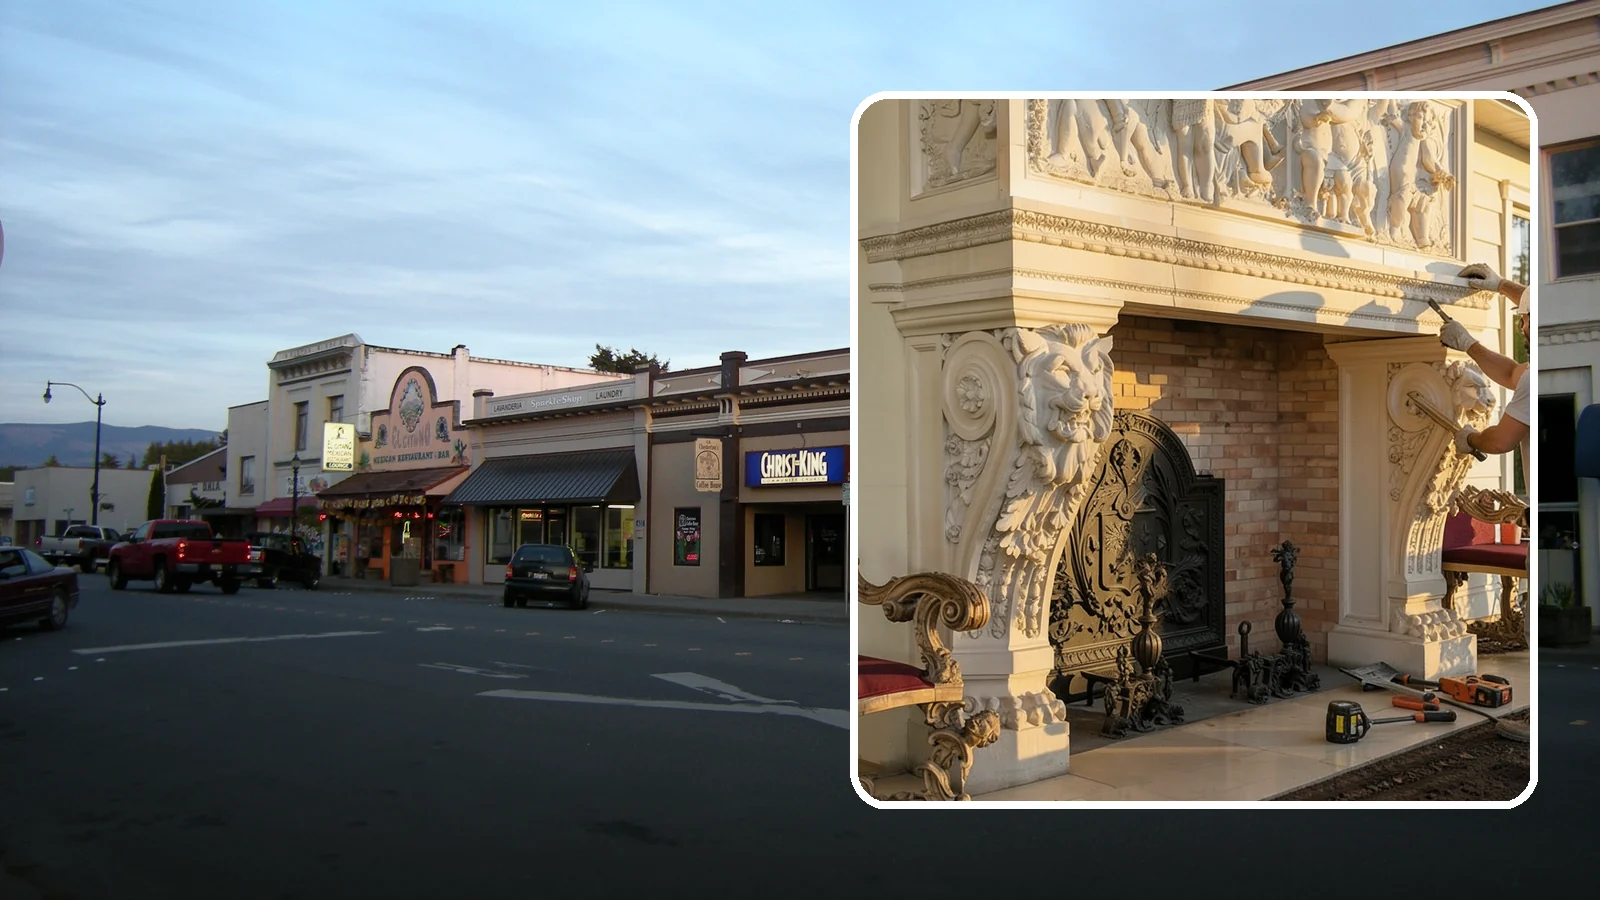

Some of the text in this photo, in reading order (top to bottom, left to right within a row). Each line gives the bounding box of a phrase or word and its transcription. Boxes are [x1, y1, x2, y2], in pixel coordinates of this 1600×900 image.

[595, 389, 623, 400] LAUNDRY
[494, 402, 522, 412] LAVANDERIA
[531, 395, 582, 408] Sparkle Shop
[392, 425, 401, 449] EL
[373, 455, 396, 464] MEXICAN
[397, 451, 433, 462] RESTAURANT
[438, 450, 450, 459] BAR
[761, 450, 828, 478] CHRIST KING
